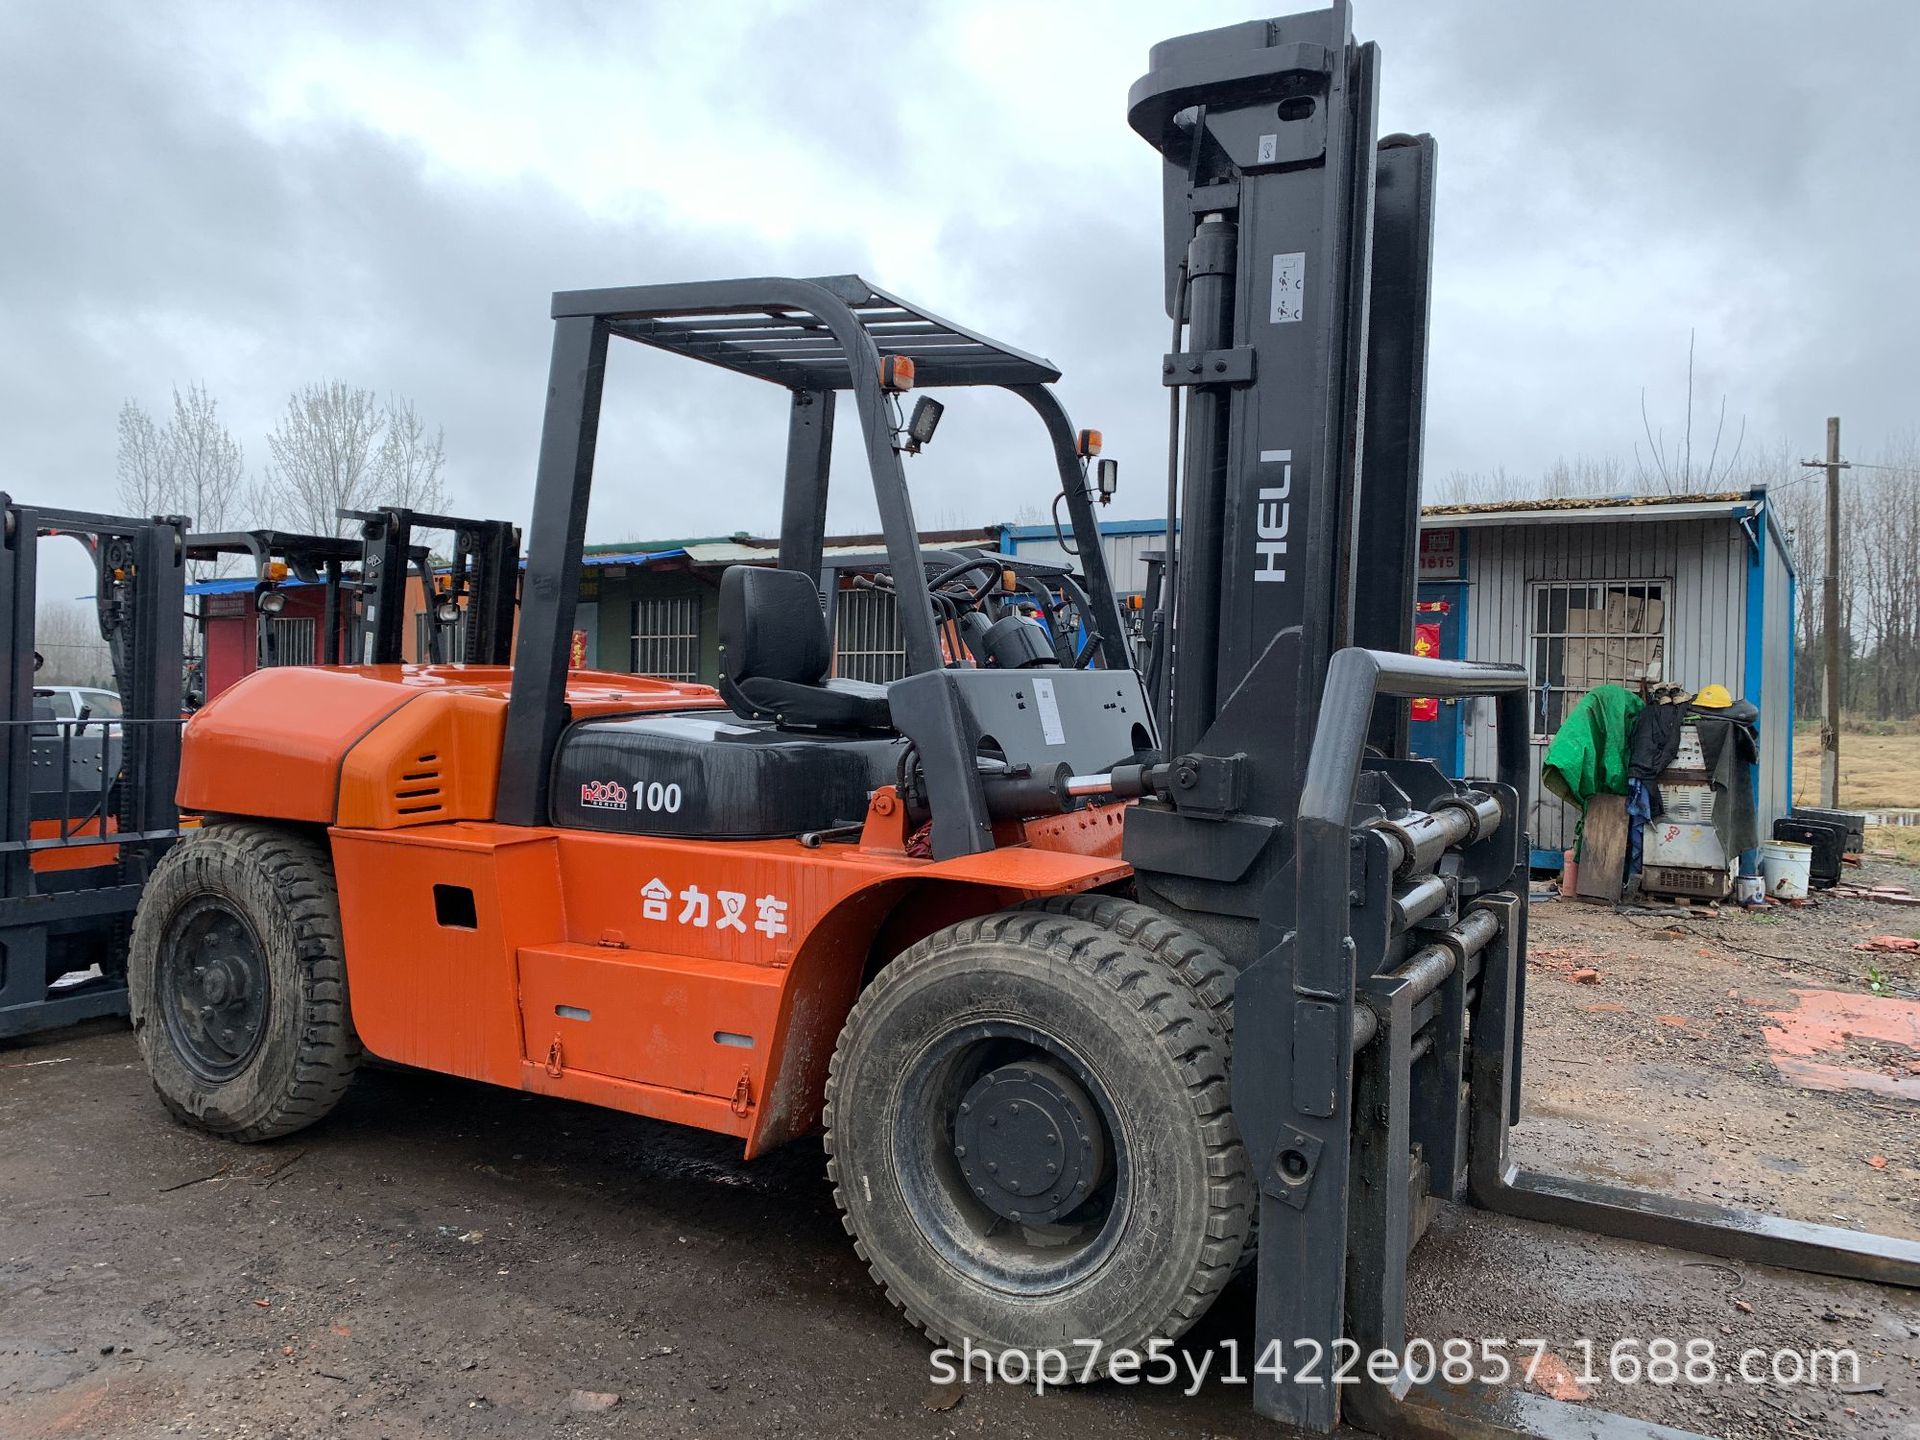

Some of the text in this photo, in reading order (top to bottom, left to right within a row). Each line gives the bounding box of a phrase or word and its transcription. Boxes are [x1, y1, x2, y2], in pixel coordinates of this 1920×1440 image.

[1254, 449, 1292, 582] HELI
[632, 781, 681, 813] 100
[640, 877, 788, 939] 合力叉车
